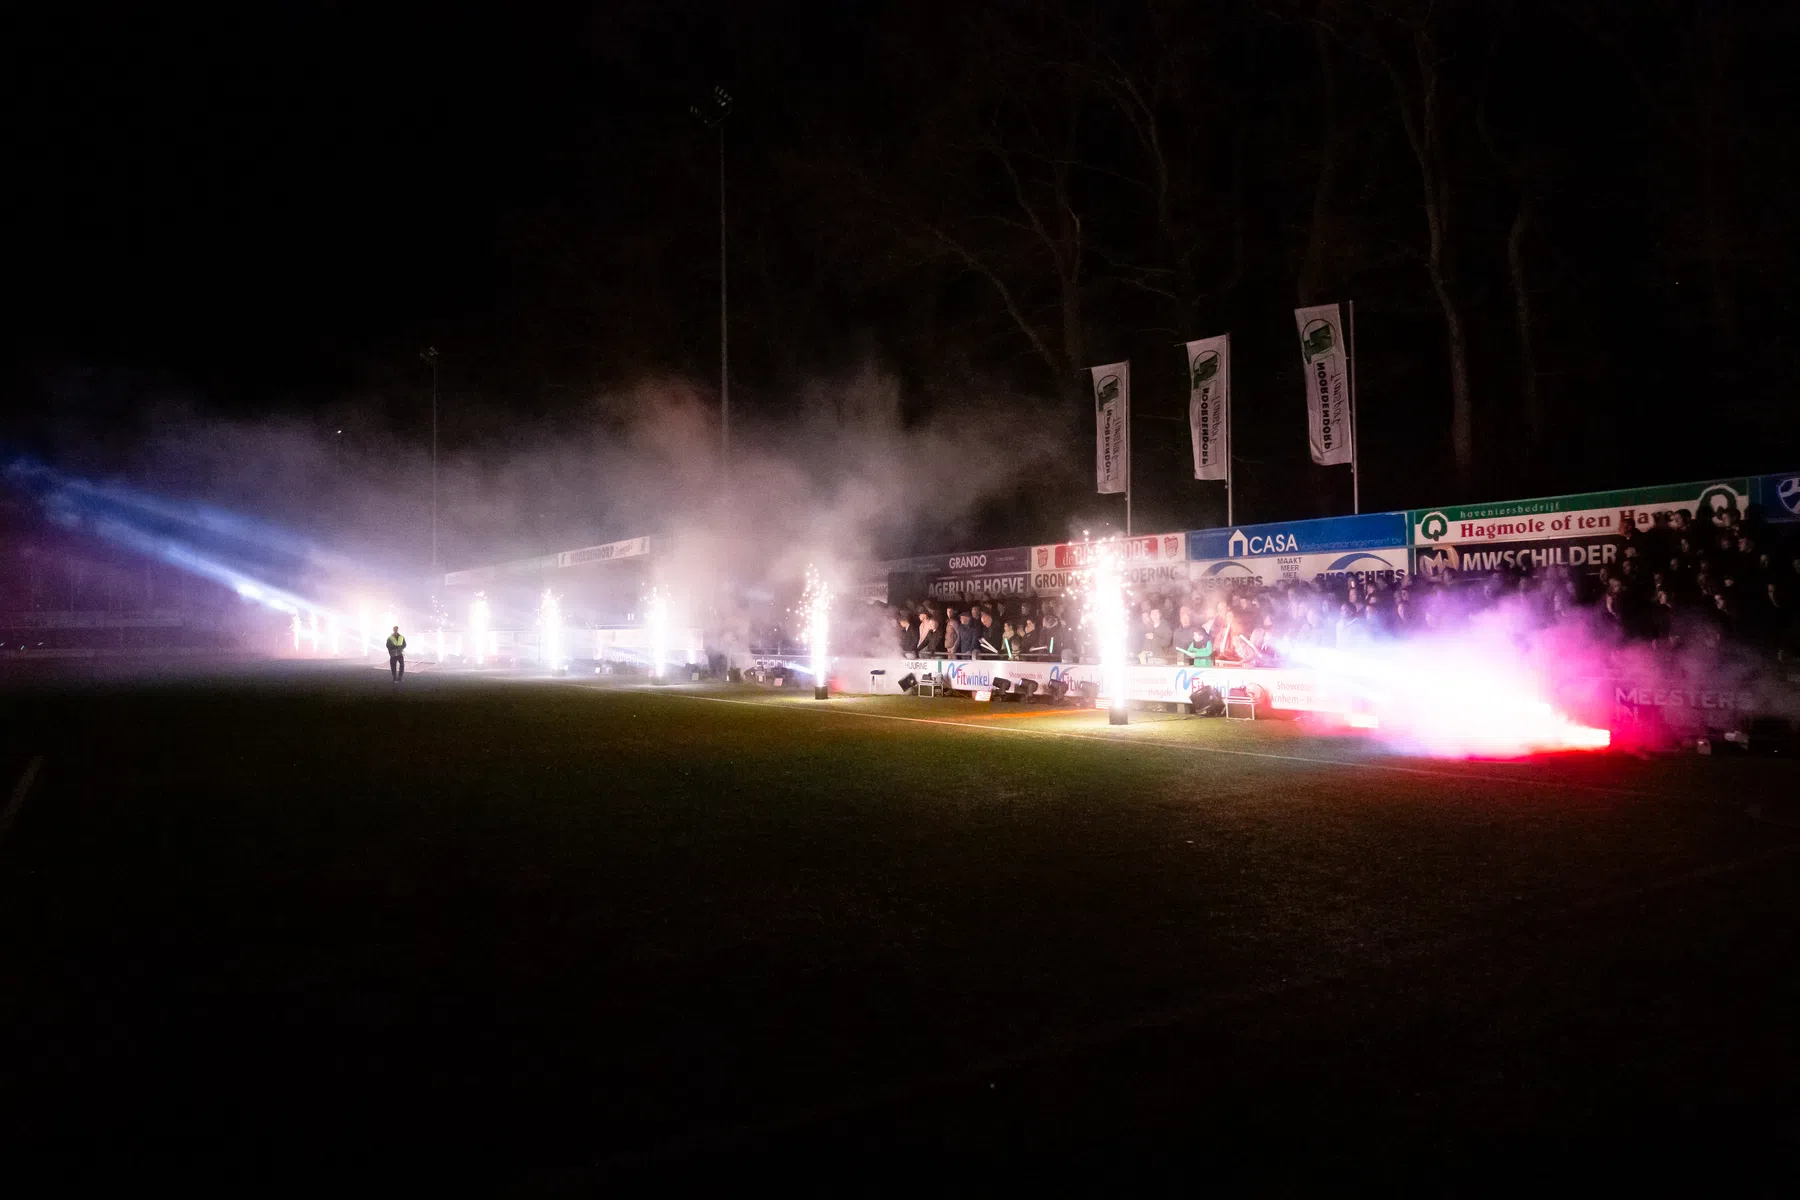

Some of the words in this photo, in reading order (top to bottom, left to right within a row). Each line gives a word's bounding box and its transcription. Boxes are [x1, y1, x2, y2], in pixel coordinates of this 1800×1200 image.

[1460, 502, 1561, 518] hoveniersbedrijf
[1460, 518, 1545, 540] Hagmole
[1550, 514, 1573, 531] of
[1577, 515, 1612, 530] ten
[1249, 533, 1298, 554] CASA
[949, 554, 987, 569] GRANDO
[966, 580, 981, 592] DE
[984, 577, 1024, 594] HOEVE
[957, 668, 990, 687] Fitwinkel
